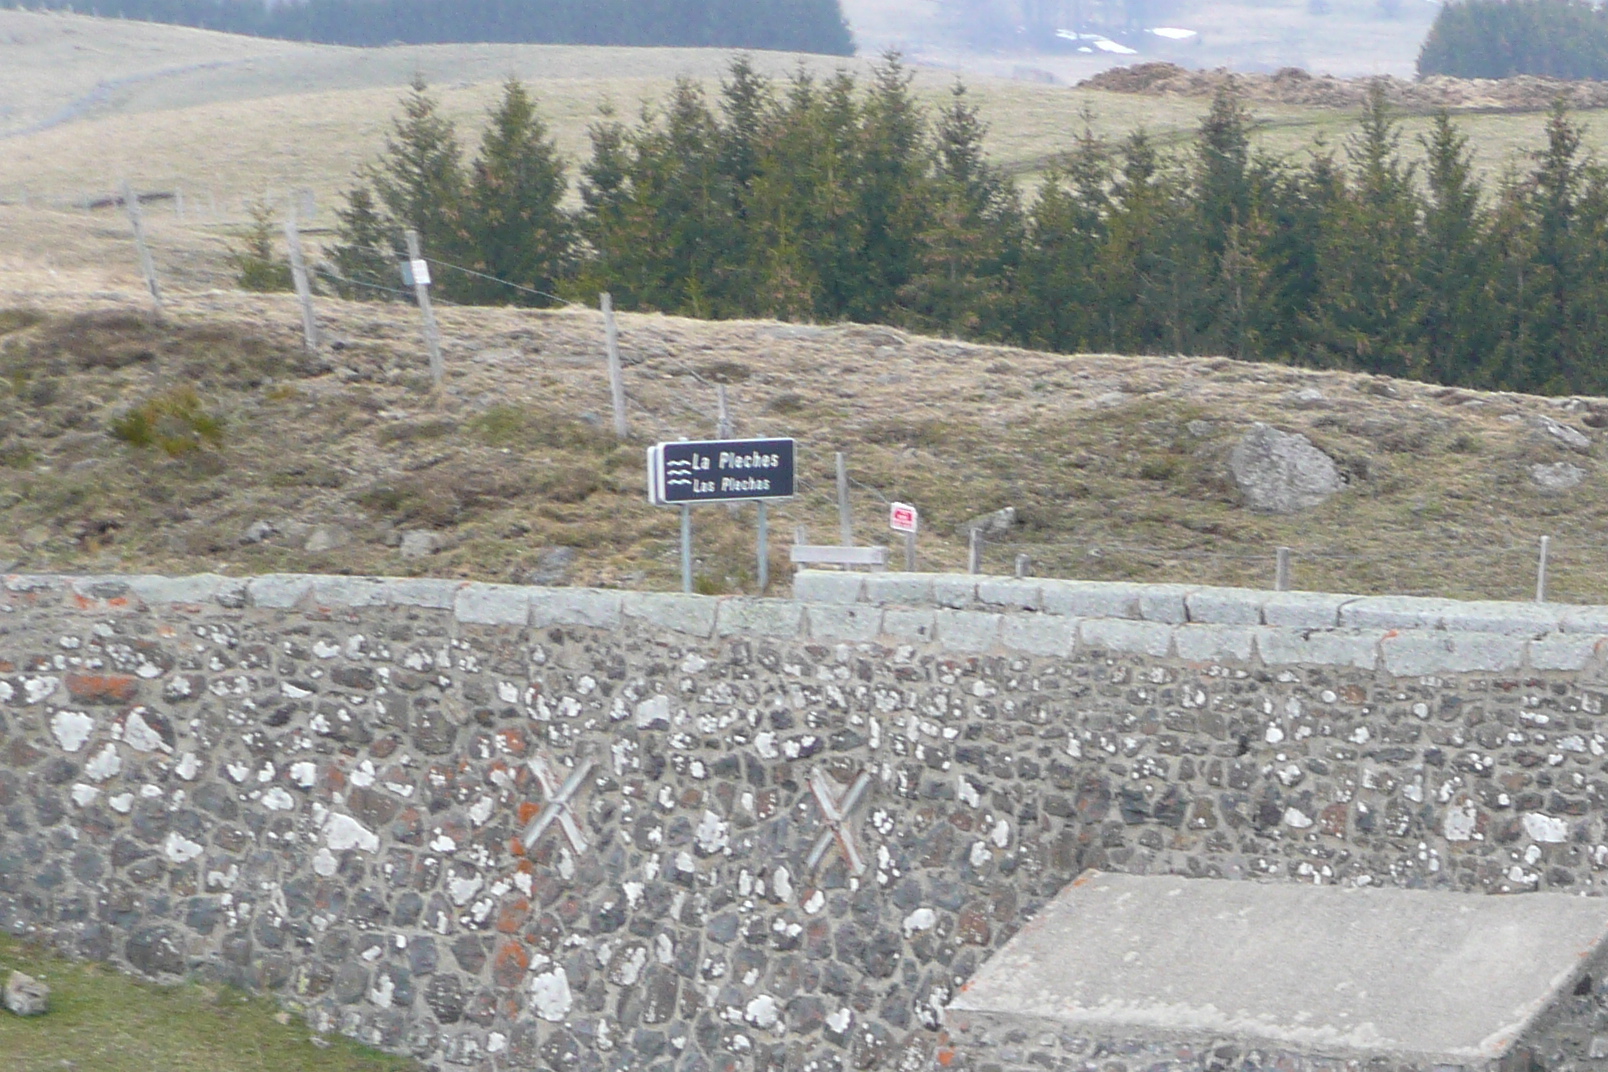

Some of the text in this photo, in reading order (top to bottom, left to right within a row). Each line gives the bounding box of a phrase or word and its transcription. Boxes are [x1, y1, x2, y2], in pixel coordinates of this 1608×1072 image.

[692, 451, 779, 470] La Pleches
[693, 478, 715, 493] Las
